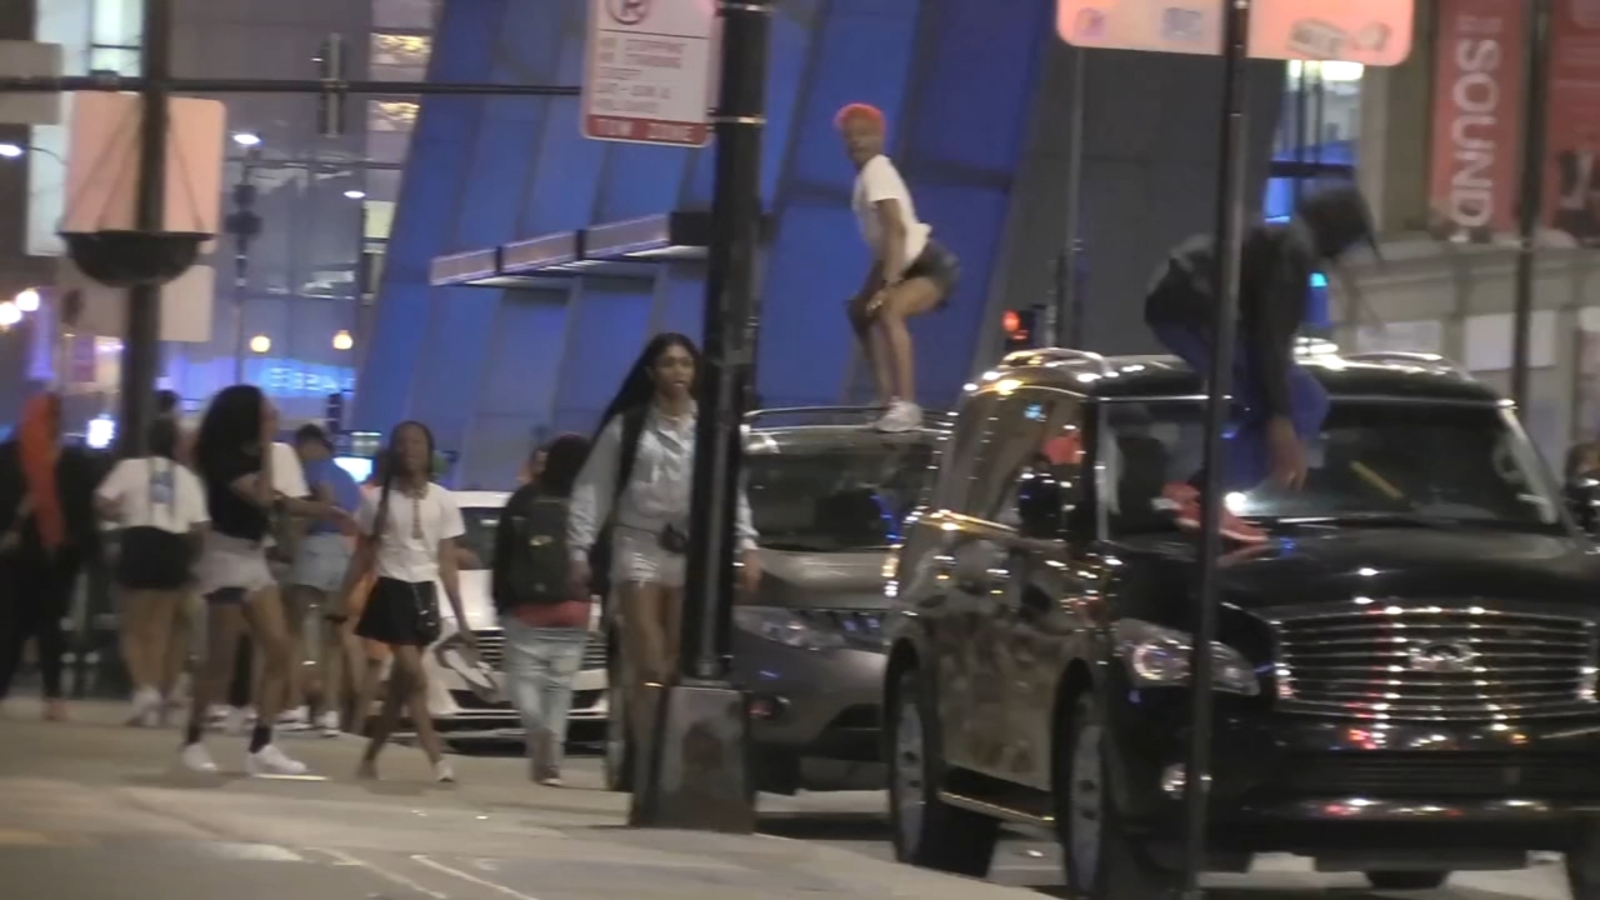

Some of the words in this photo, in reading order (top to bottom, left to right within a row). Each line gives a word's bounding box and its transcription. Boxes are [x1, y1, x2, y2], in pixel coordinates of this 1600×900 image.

[594, 118, 632, 137] TOW
[647, 122, 695, 141] ZONE
[1452, 39, 1501, 227] SOUND
